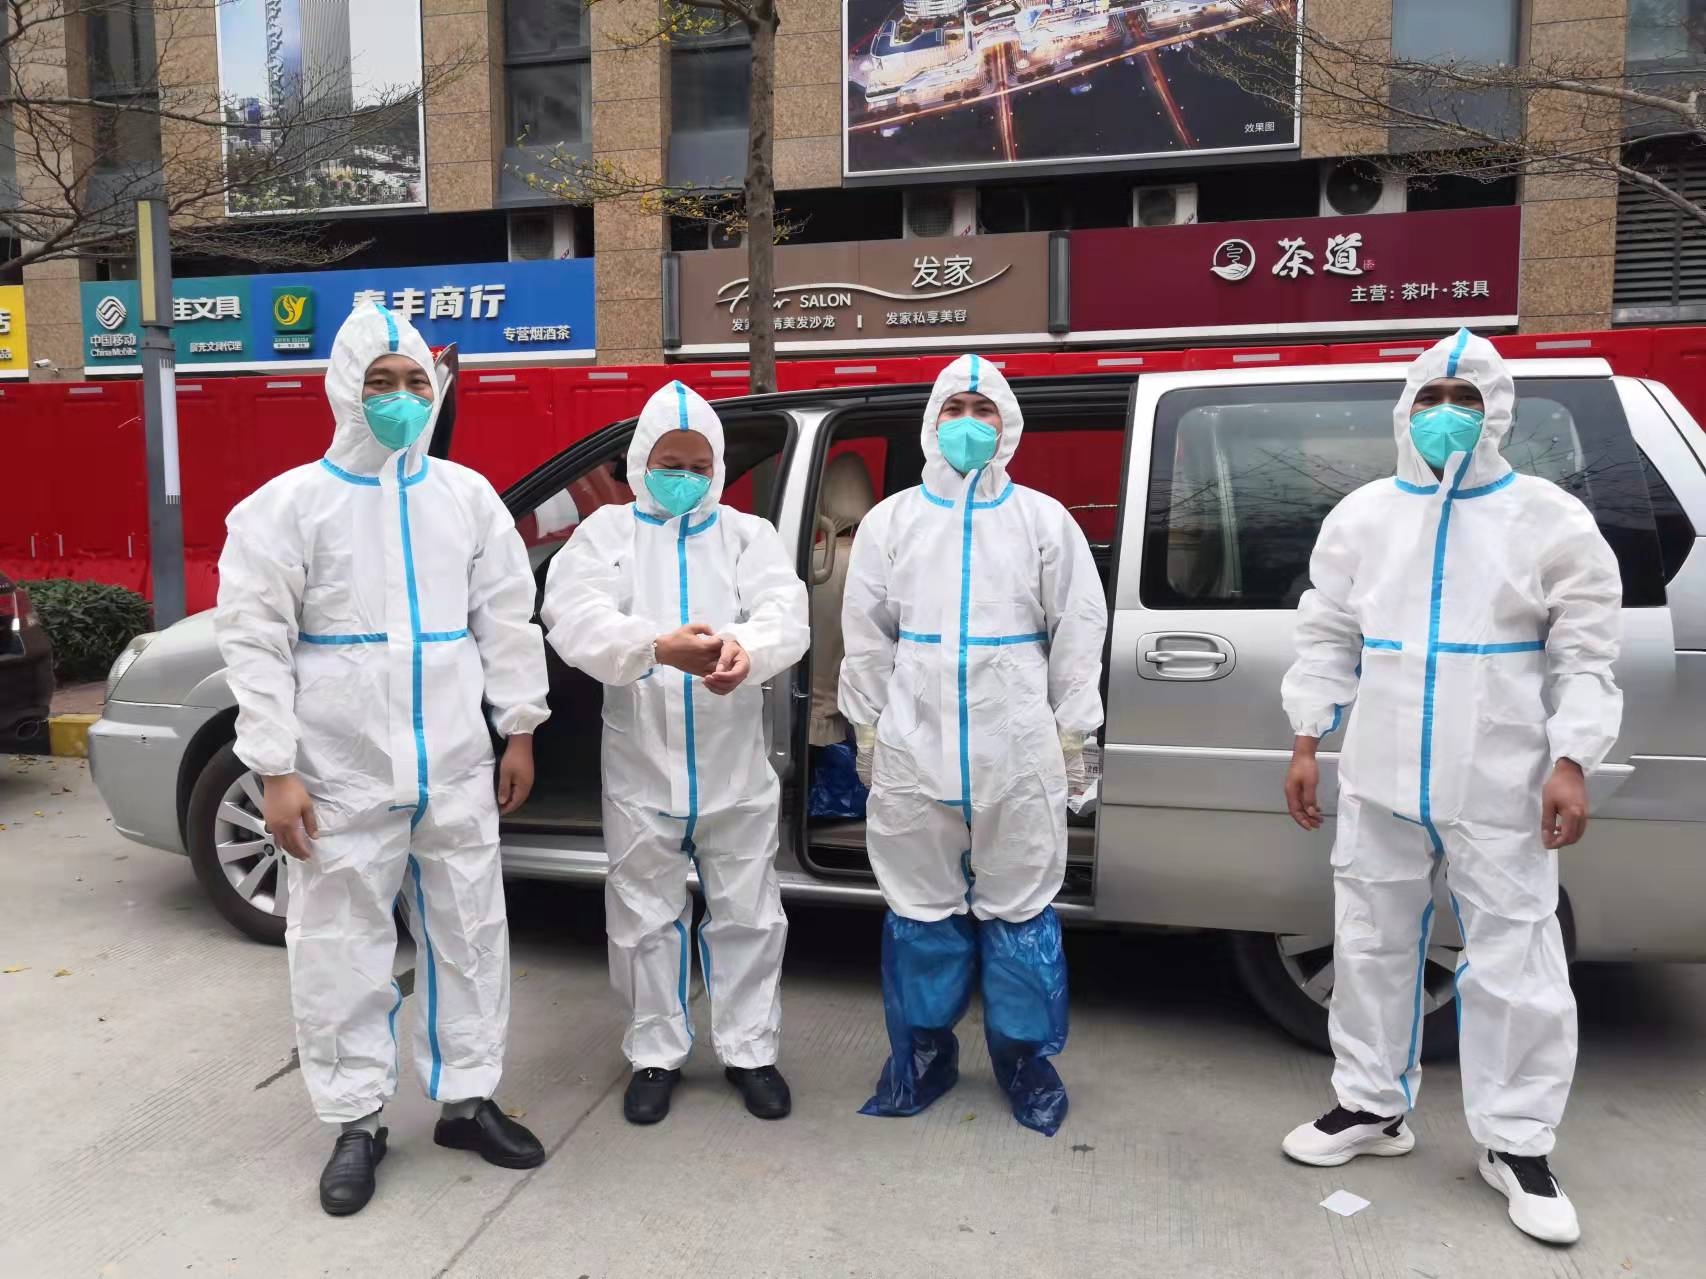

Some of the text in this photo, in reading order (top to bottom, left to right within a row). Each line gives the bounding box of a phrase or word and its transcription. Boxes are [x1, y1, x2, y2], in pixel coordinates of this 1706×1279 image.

[1243, 120, 1276, 134] 效果图
[1272, 232, 1364, 279] 茶道
[911, 255, 974, 288] 发家
[799, 293, 852, 308] SALON
[885, 309, 968, 325] 发家私享美容
[90, 333, 137, 347] 中国移动
[503, 324, 571, 342] 专营烟酒茶
